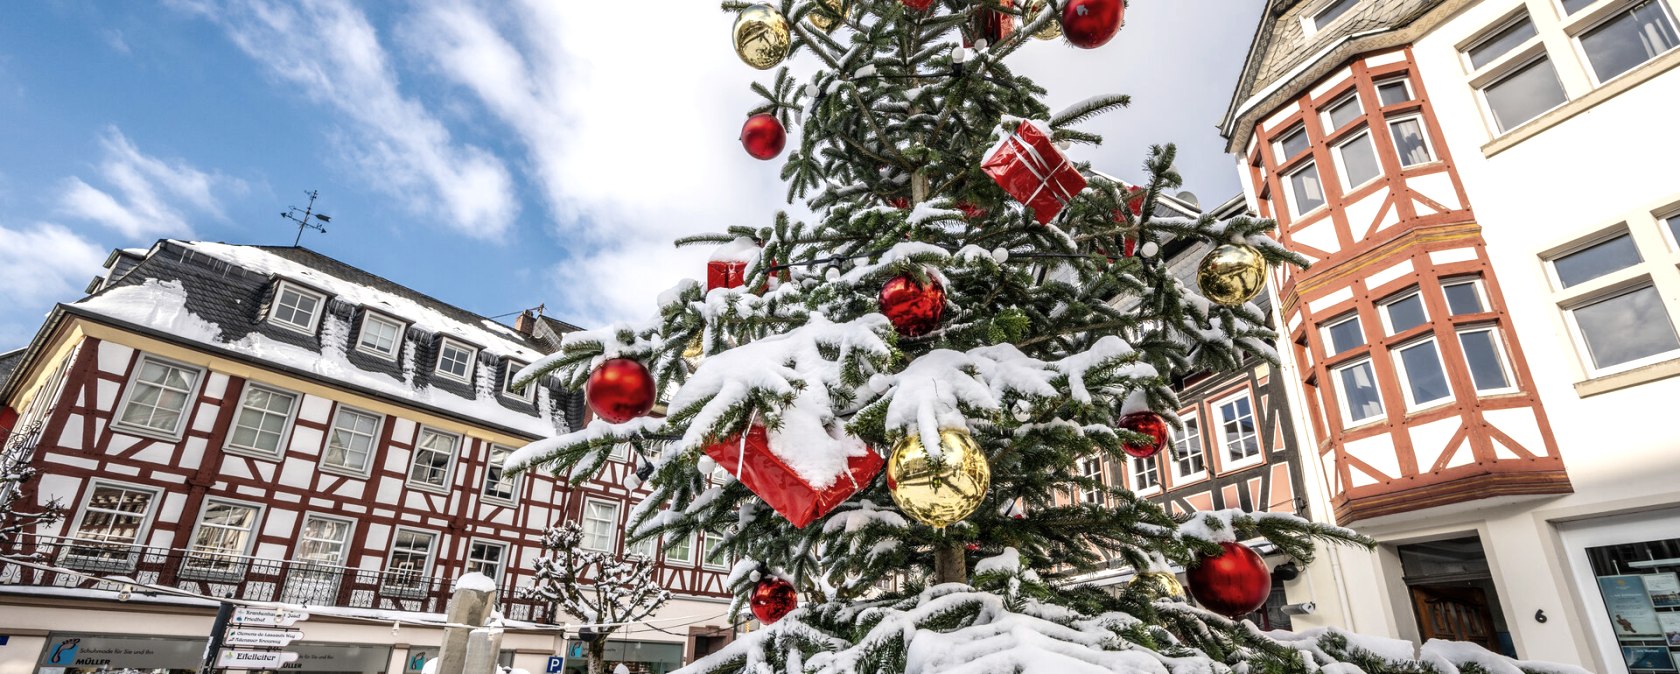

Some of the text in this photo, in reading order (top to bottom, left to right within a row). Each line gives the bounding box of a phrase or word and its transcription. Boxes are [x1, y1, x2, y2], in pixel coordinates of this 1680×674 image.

[1535, 608, 1548, 624] 6
[236, 652, 276, 661] Eifelleiter
[75, 657, 111, 666] MÜLLER
[281, 661, 302, 669] ÜLLER
[550, 658, 560, 671] P
